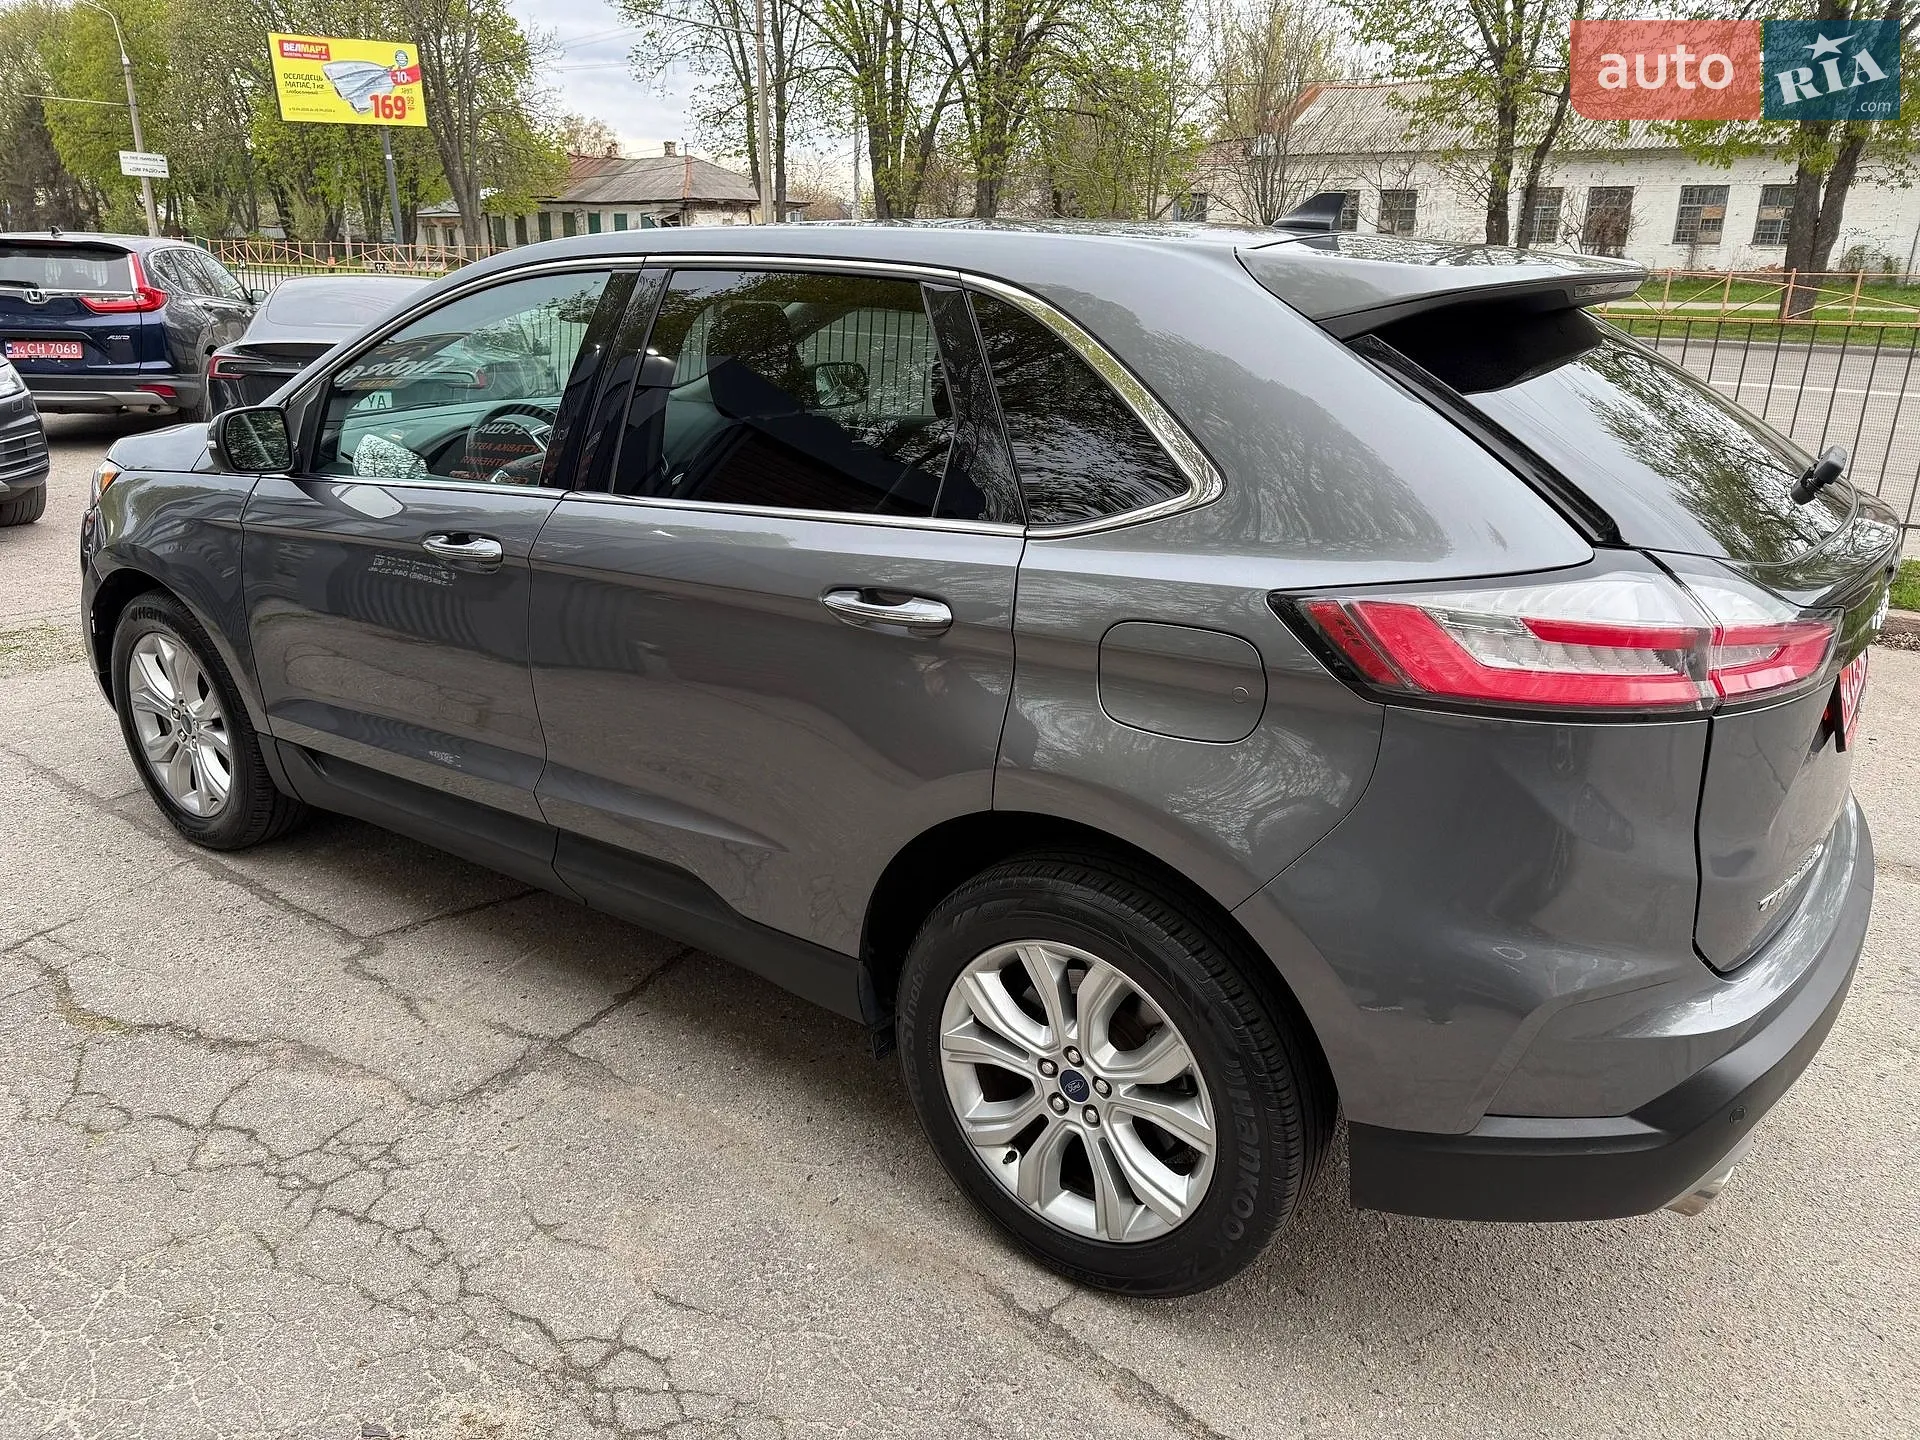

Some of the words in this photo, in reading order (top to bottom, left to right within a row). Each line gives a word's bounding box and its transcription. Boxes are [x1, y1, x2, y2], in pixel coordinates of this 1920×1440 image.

[282, 42, 328, 54] ВЕЛМАРТ
[283, 72, 324, 82] ОСЕЛЕДЕЦЬ
[369, 94, 406, 120] 169
[15, 345, 26, 354] 14
[48, 343, 78, 354] 7068
